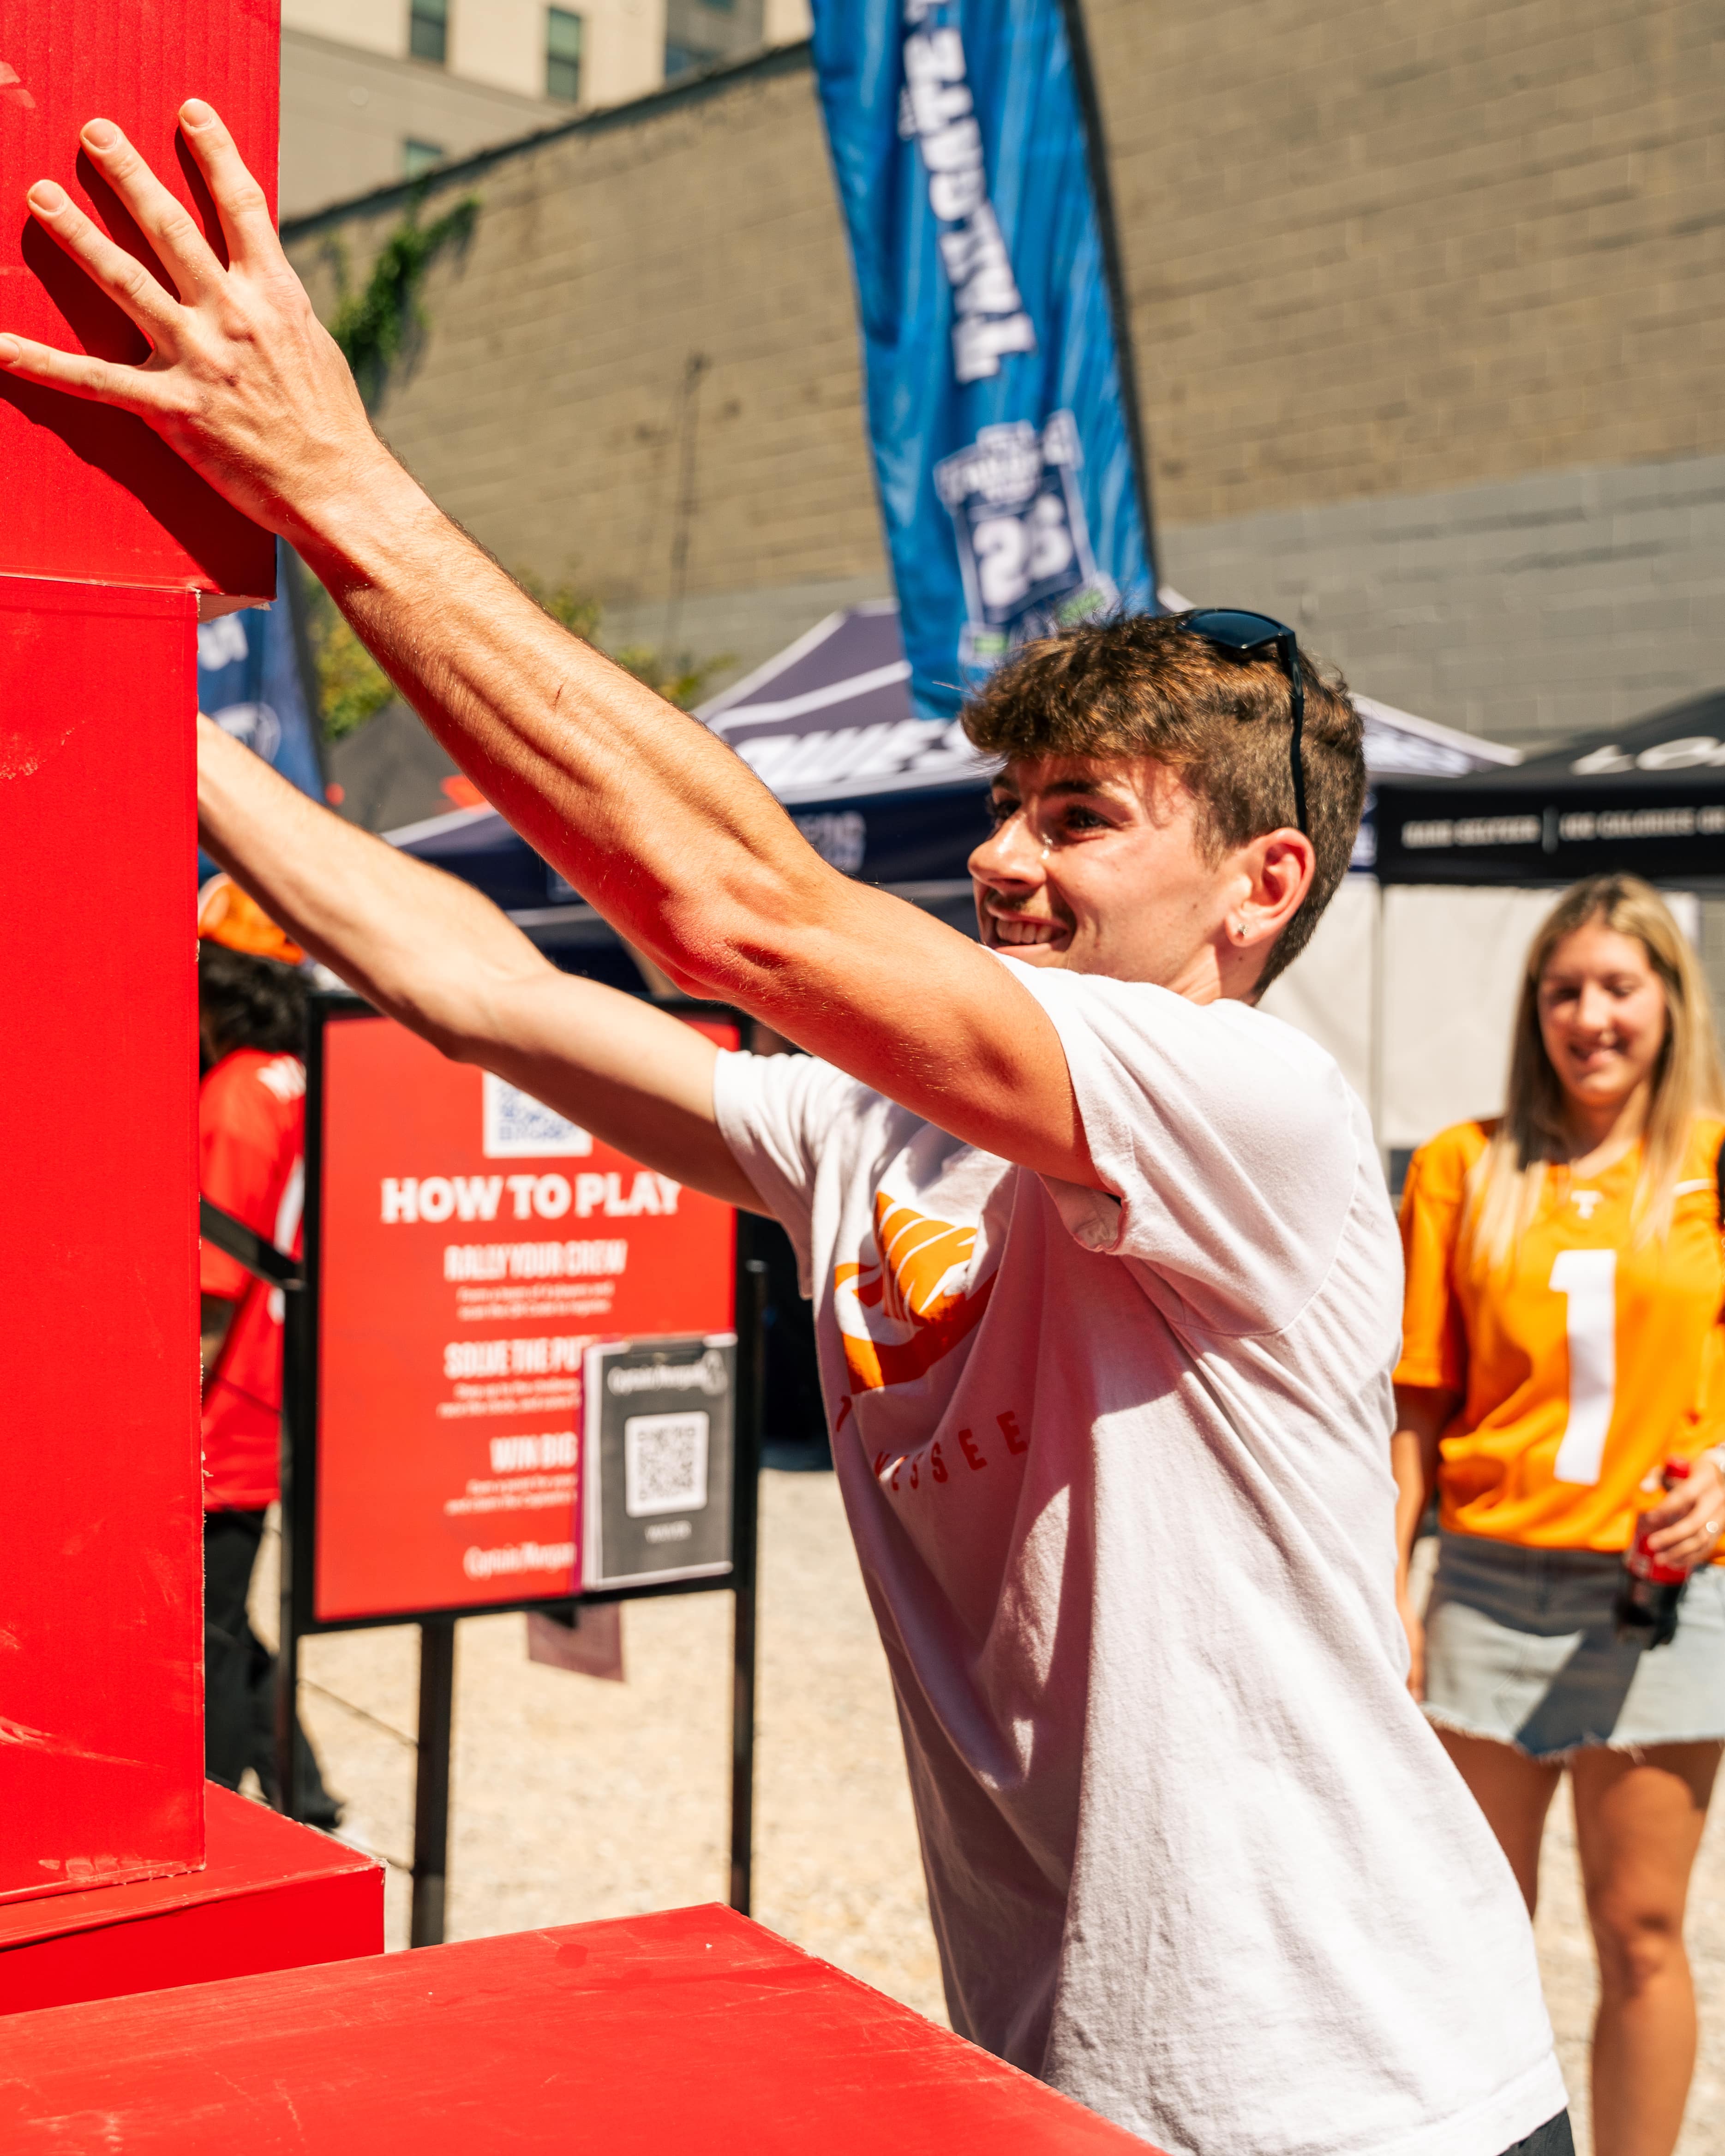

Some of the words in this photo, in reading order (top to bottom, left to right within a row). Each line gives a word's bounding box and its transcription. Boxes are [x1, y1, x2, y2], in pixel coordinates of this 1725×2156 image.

[904, 27, 1037, 384] TAILGATE
[381, 1176, 504, 1224] HOW
[506, 1173, 572, 1220] TO
[575, 1170, 682, 1218] PLAY
[1571, 1190, 1604, 1220] T
[444, 1244, 509, 1282] RALLY
[508, 1241, 563, 1279] YOUR
[563, 1238, 628, 1277] CREW
[443, 1341, 508, 1379] SOLVE
[510, 1336, 548, 1375] THE
[1549, 1248, 1617, 1486] 1
[490, 1435, 539, 1473] WIN
[540, 1431, 578, 1469] BIG
